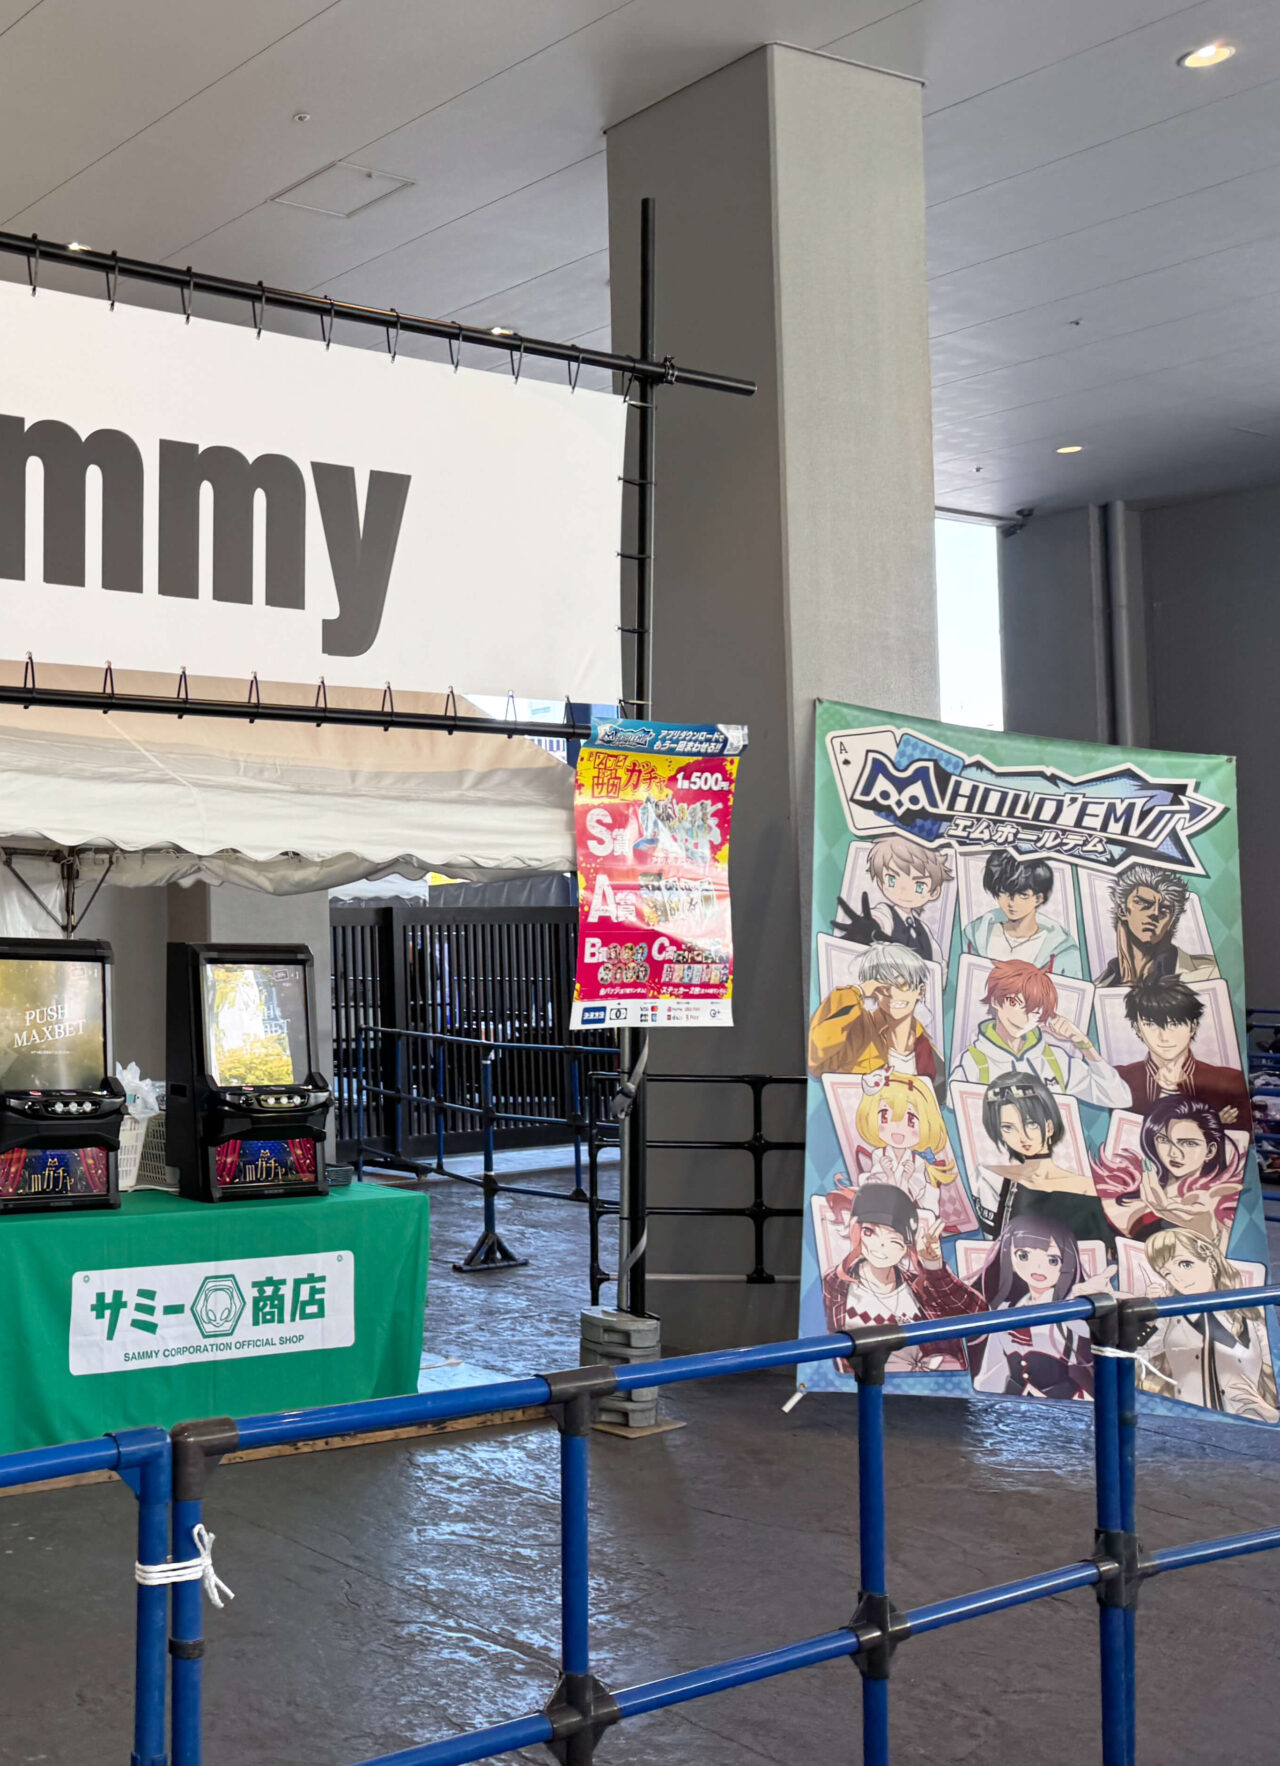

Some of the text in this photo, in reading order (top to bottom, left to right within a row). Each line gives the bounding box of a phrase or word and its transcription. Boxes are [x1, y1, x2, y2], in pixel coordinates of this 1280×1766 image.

[838, 741, 849, 755] A
[947, 817, 1110, 855] エムホールデム
[25, 1003, 68, 1026] PUSH
[13, 1019, 87, 1049] MAXBET
[90, 1273, 327, 1341] サミー 商店
[123, 1334, 305, 1362] SAMMY CORPORATION OFFICIAL SHOP
